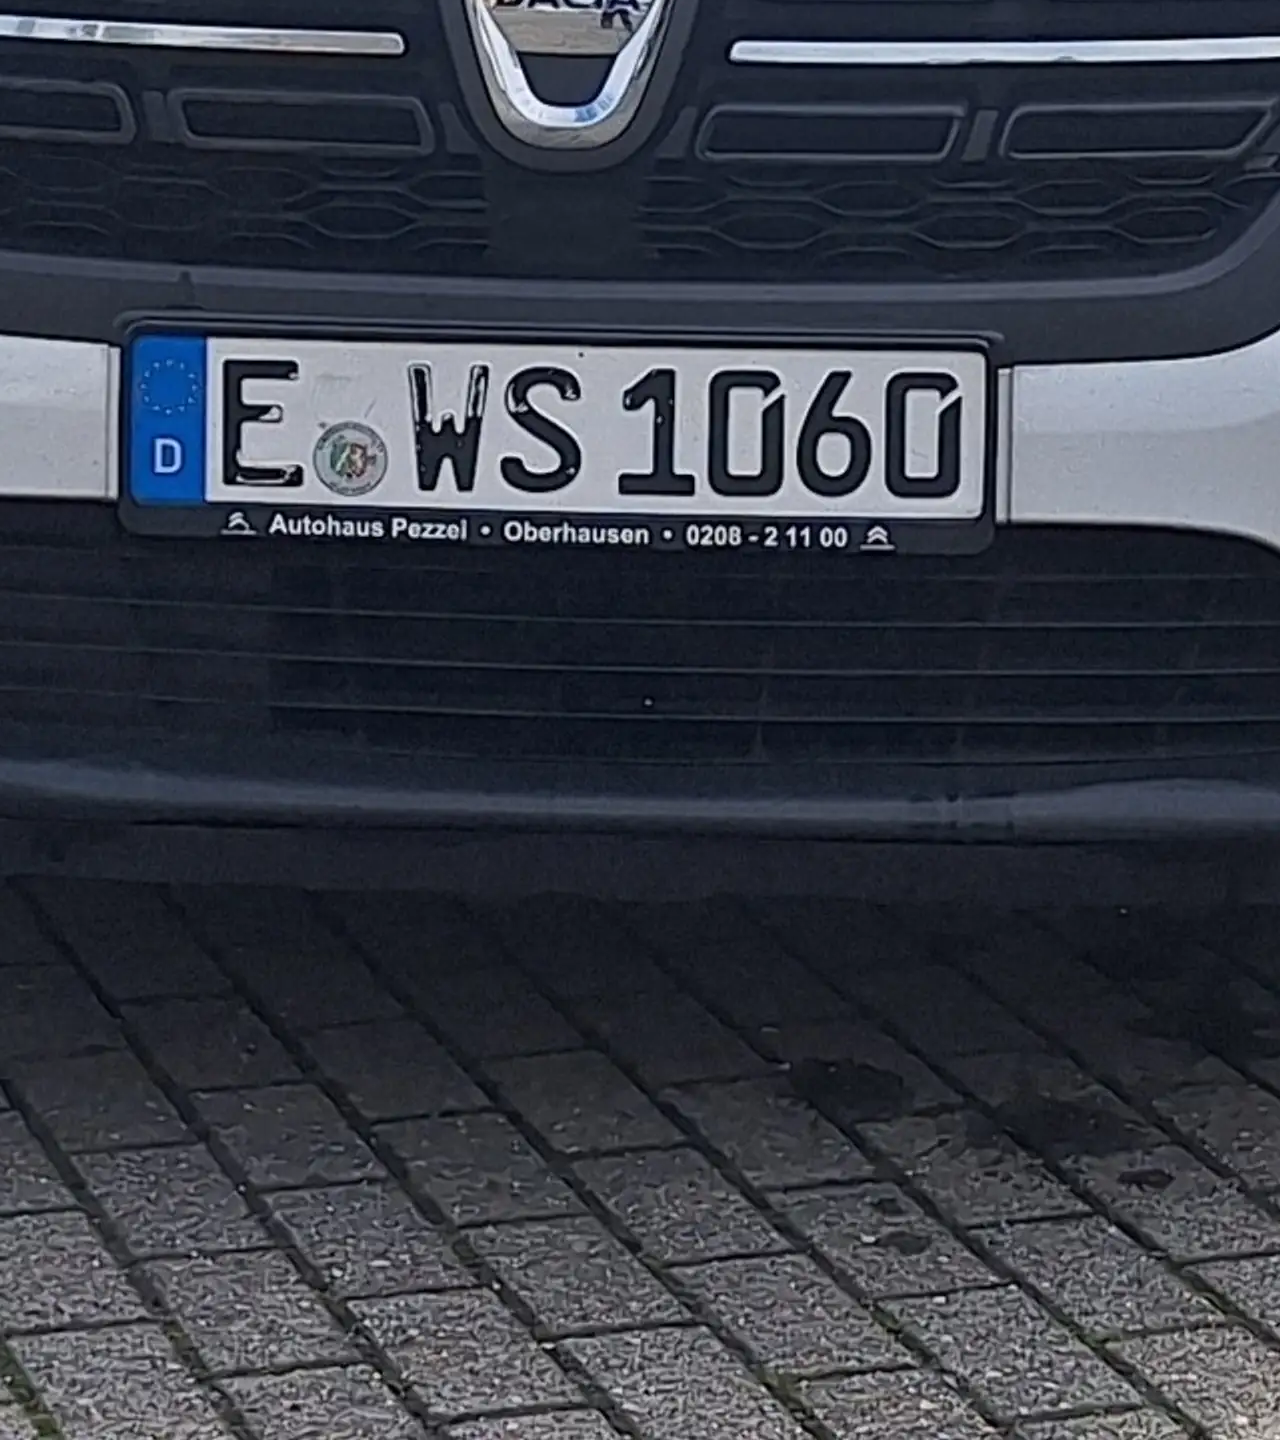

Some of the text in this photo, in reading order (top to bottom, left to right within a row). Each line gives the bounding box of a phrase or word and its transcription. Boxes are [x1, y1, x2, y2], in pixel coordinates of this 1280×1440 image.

[222, 360, 963, 500] E WS 1060
[154, 439, 182, 474] D
[269, 513, 384, 537] Autohaus
[391, 518, 468, 541] Pezzel
[504, 520, 650, 545] Oberhausen
[686, 524, 742, 546] 0208
[764, 527, 779, 548] 2
[786, 526, 811, 549] 11
[821, 527, 847, 549] 00
